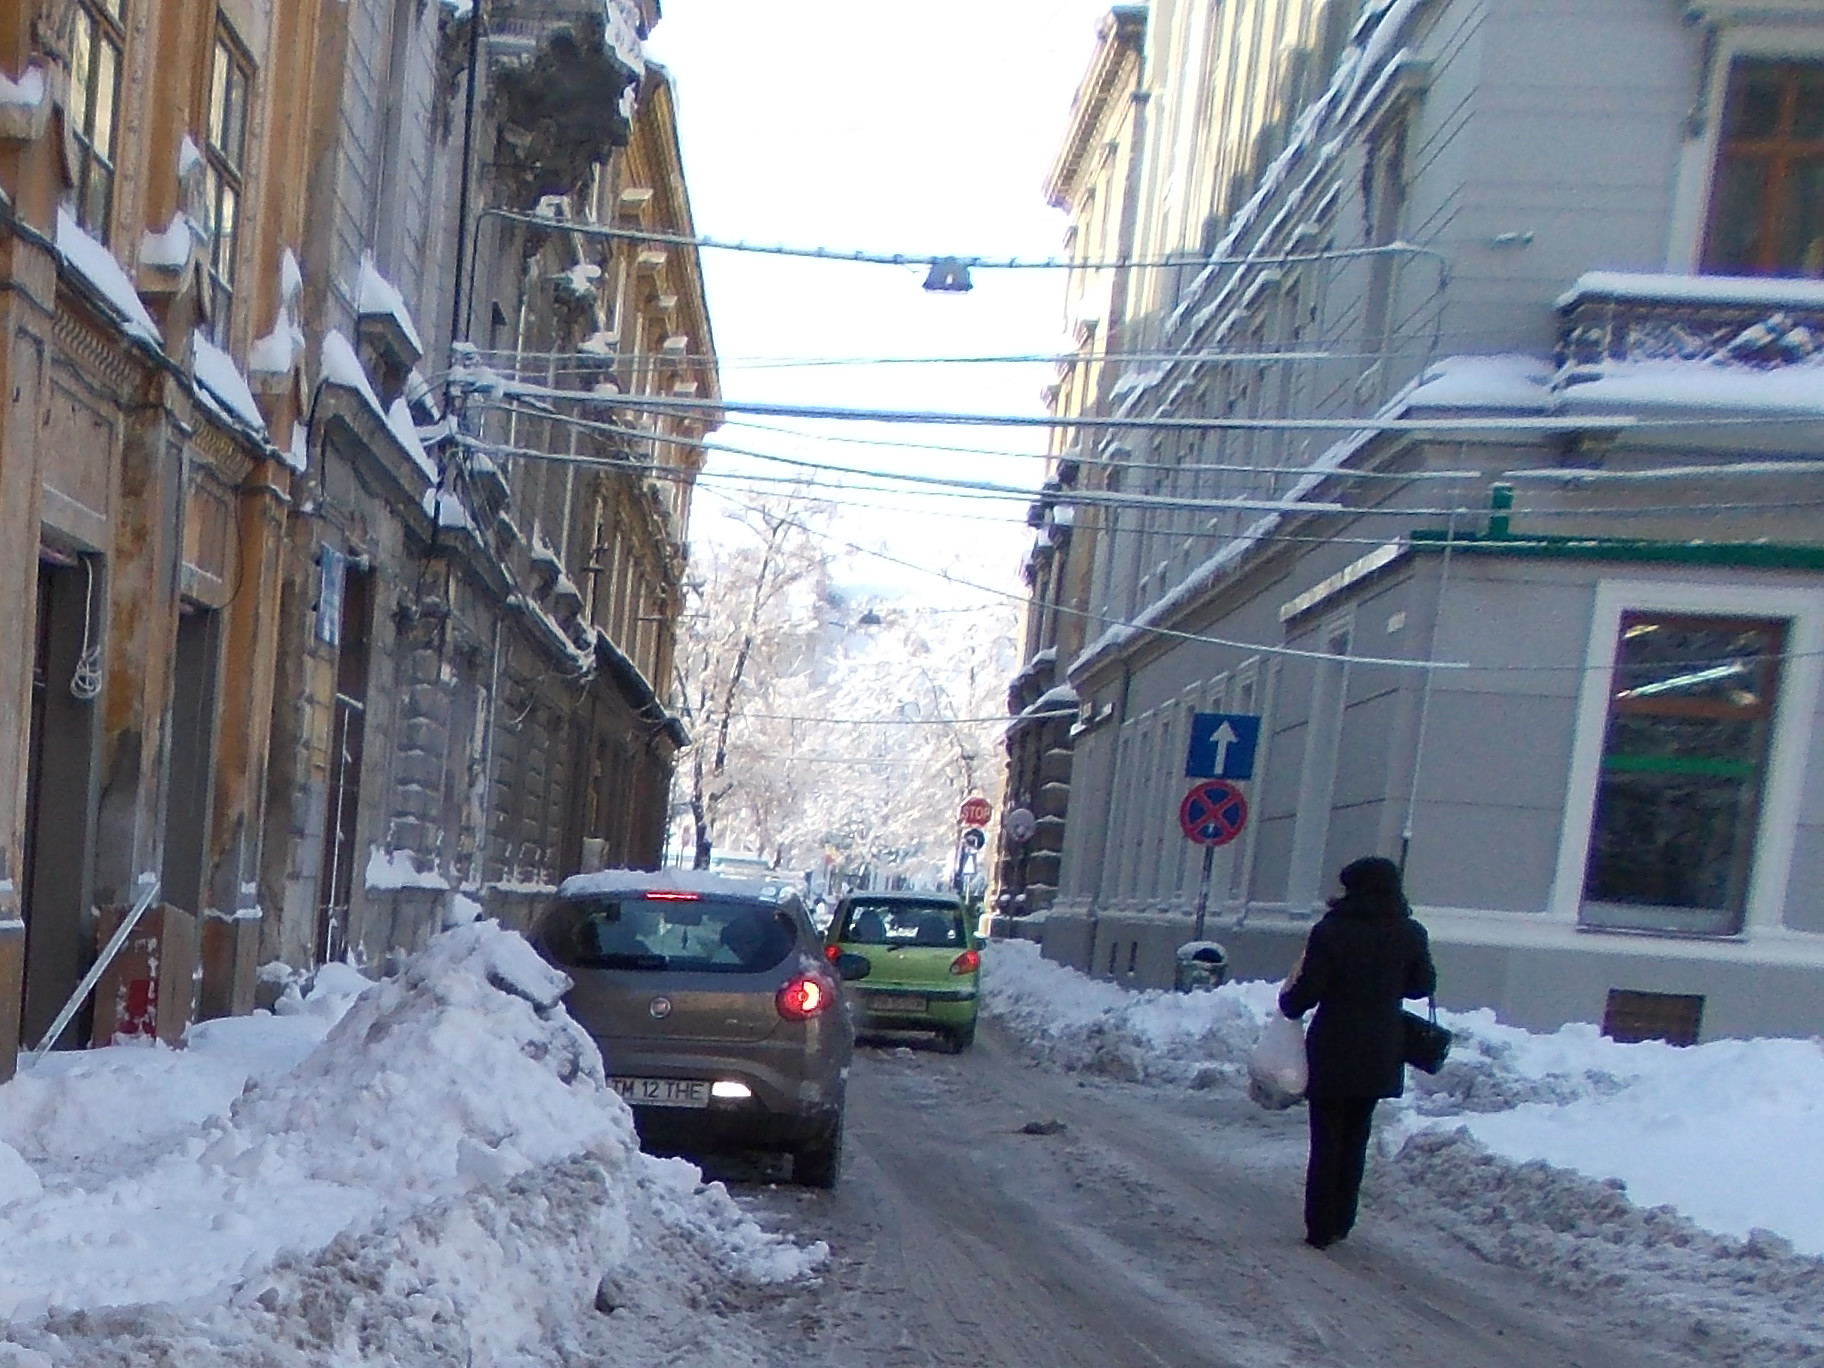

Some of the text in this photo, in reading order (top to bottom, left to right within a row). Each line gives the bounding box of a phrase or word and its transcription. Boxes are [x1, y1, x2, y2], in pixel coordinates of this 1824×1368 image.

[962, 806, 990, 820] STOP
[643, 1081, 660, 1099] 12
[666, 1083, 704, 1100] THE
